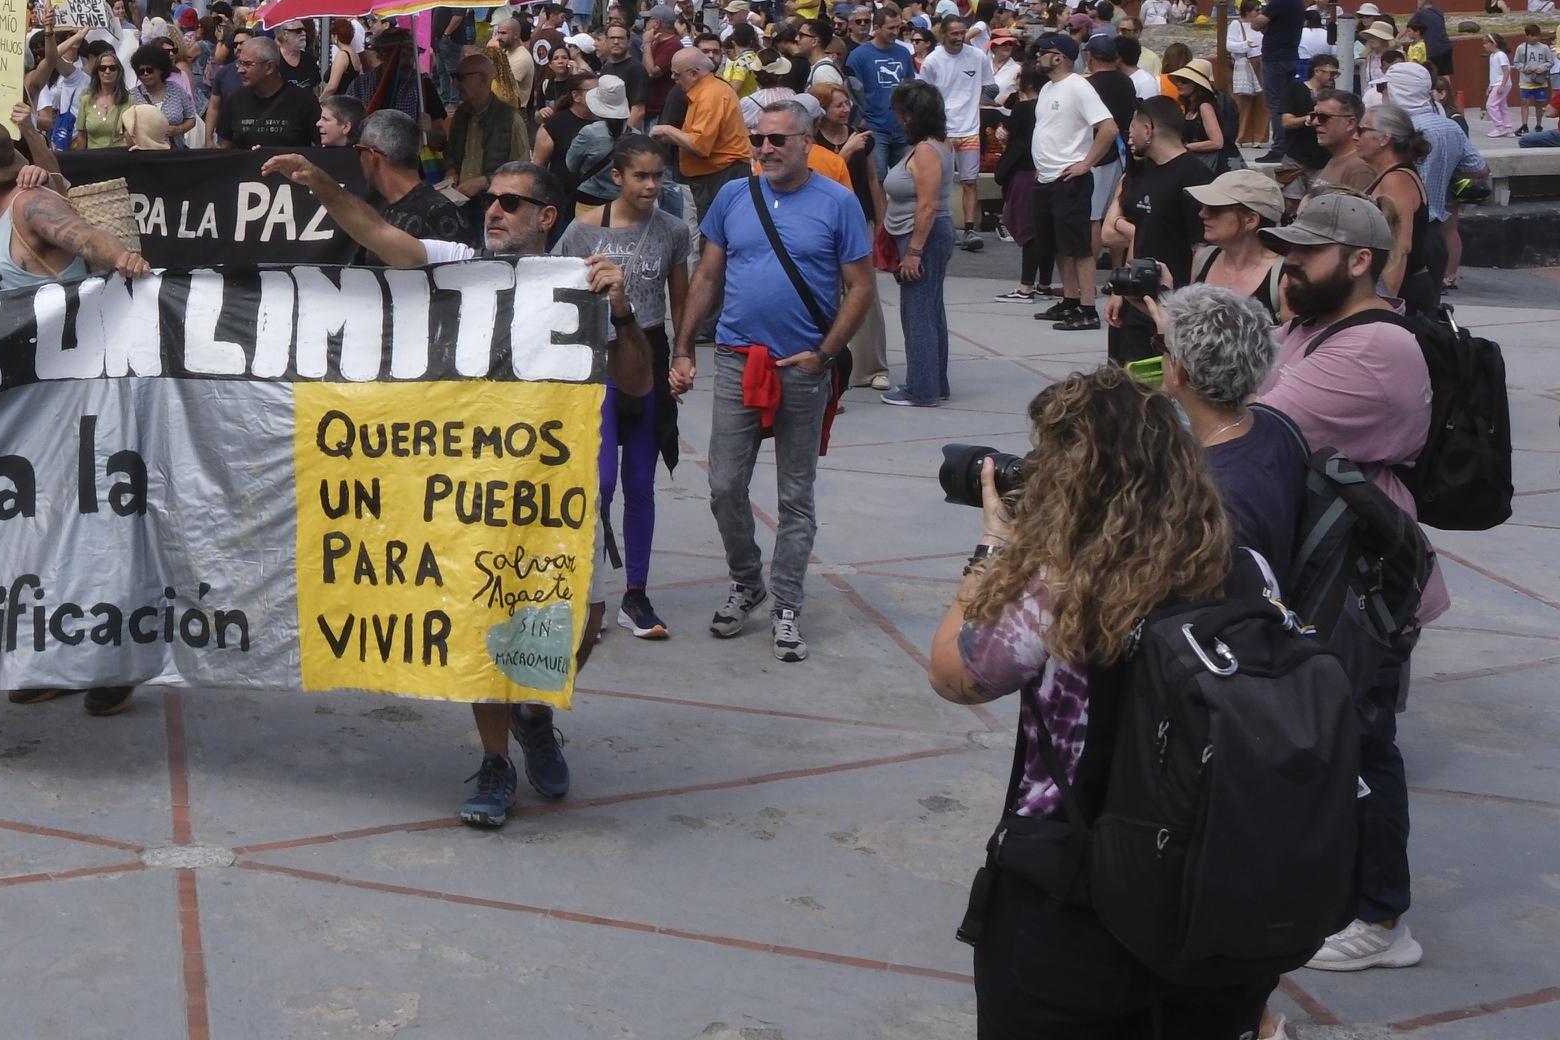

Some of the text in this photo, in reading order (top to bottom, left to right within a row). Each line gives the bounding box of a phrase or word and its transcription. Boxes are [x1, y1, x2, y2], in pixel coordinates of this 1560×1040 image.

[0, 36, 23, 56] HIJOS
[130, 193, 168, 237] RA
[177, 200, 219, 239] LA
[34, 269, 162, 380] UN
[184, 257, 593, 383] LIMITE
[316, 410, 571, 466] QUEREMOS
[78, 415, 148, 518] la
[320, 473, 587, 529] UN PUEBLO
[322, 531, 444, 587] PARA
[488, 573, 573, 617] Agaete
[317, 610, 451, 667] VIVIR
[520, 616, 552, 637] SIN
